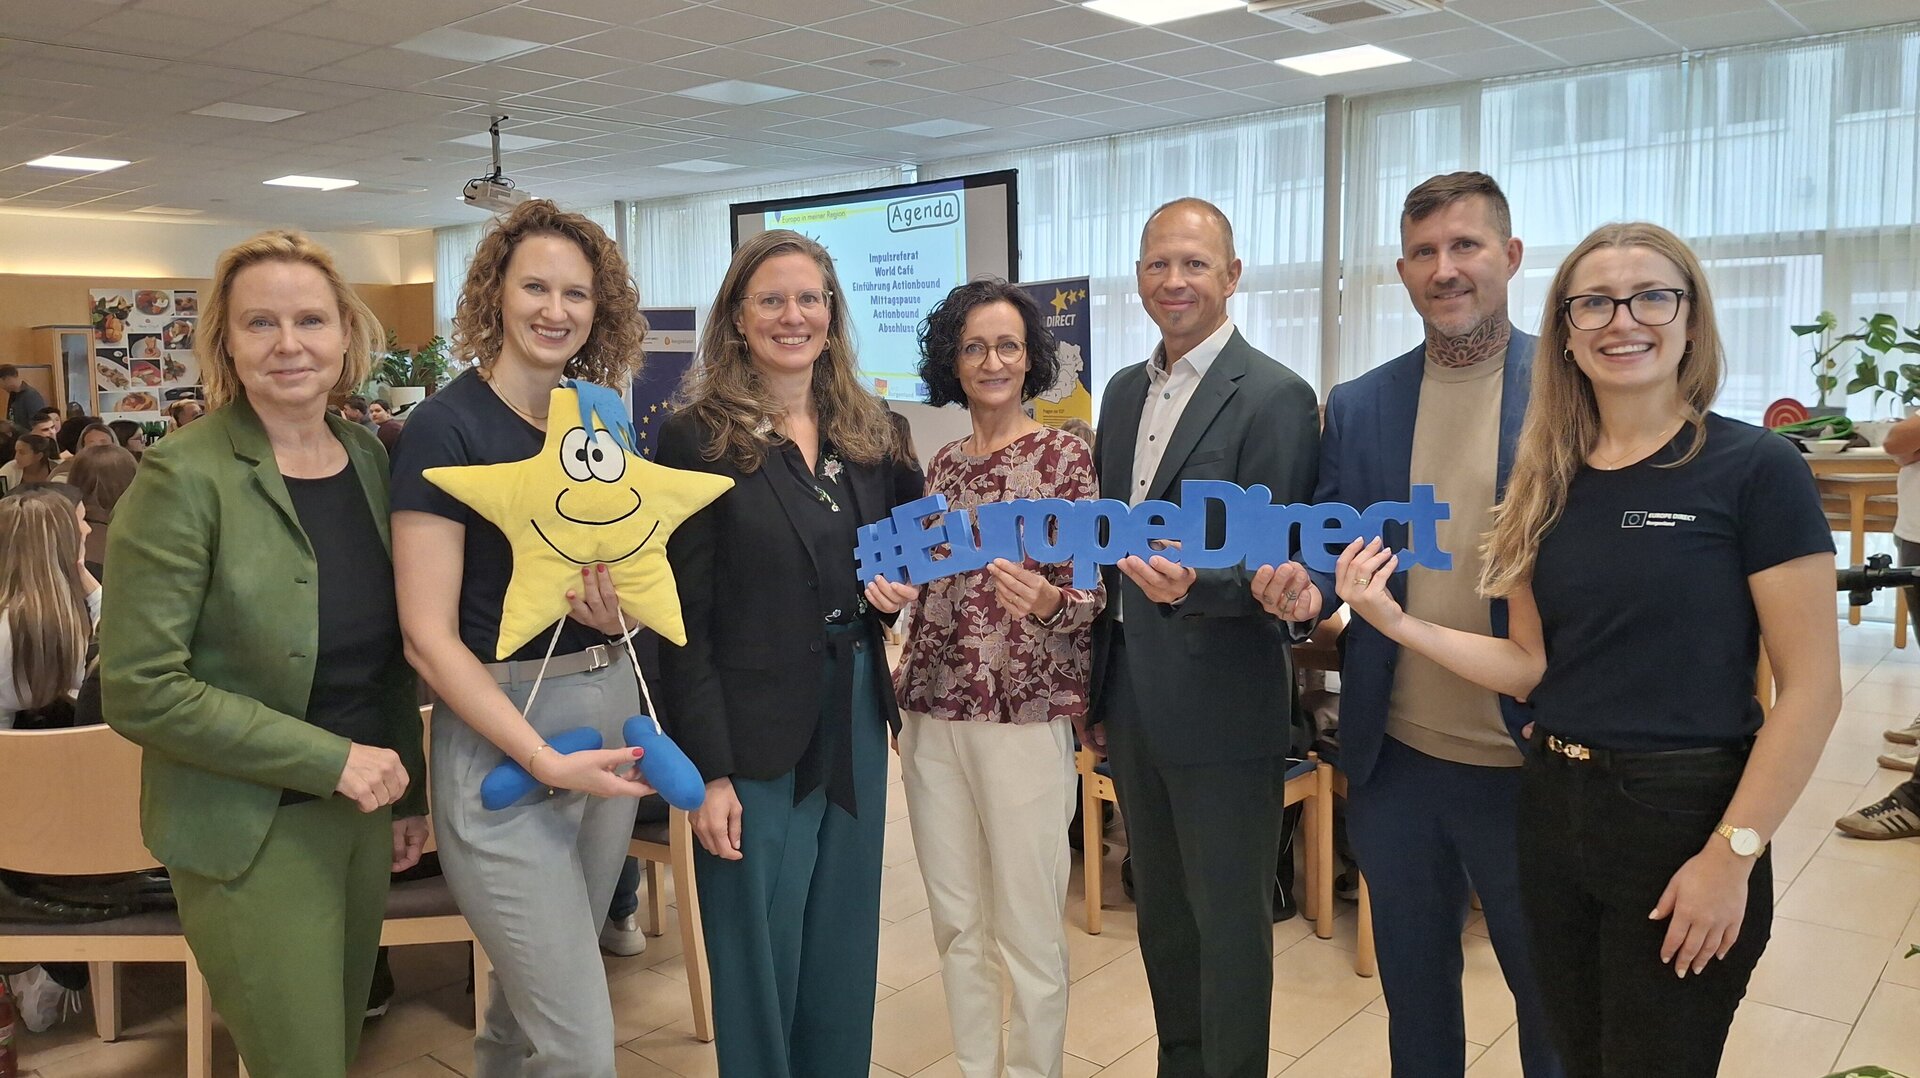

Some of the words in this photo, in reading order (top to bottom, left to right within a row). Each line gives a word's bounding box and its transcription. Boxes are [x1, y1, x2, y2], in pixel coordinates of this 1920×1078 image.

[827, 210, 846, 220] Region
[892, 200, 954, 226] Agenda
[869, 250, 919, 264] Impulsreferat
[875, 265, 896, 277] World
[897, 264, 914, 276] Café
[852, 281, 891, 292] Einführung
[892, 277, 941, 290] Actionbound
[870, 295, 921, 306] Mittagspause
[873, 308, 919, 319] Actionbound
[1046, 313, 1077, 328] DIRECT
[878, 322, 915, 333] Abschluss
[853, 479, 1453, 591] #EuropeDirect
